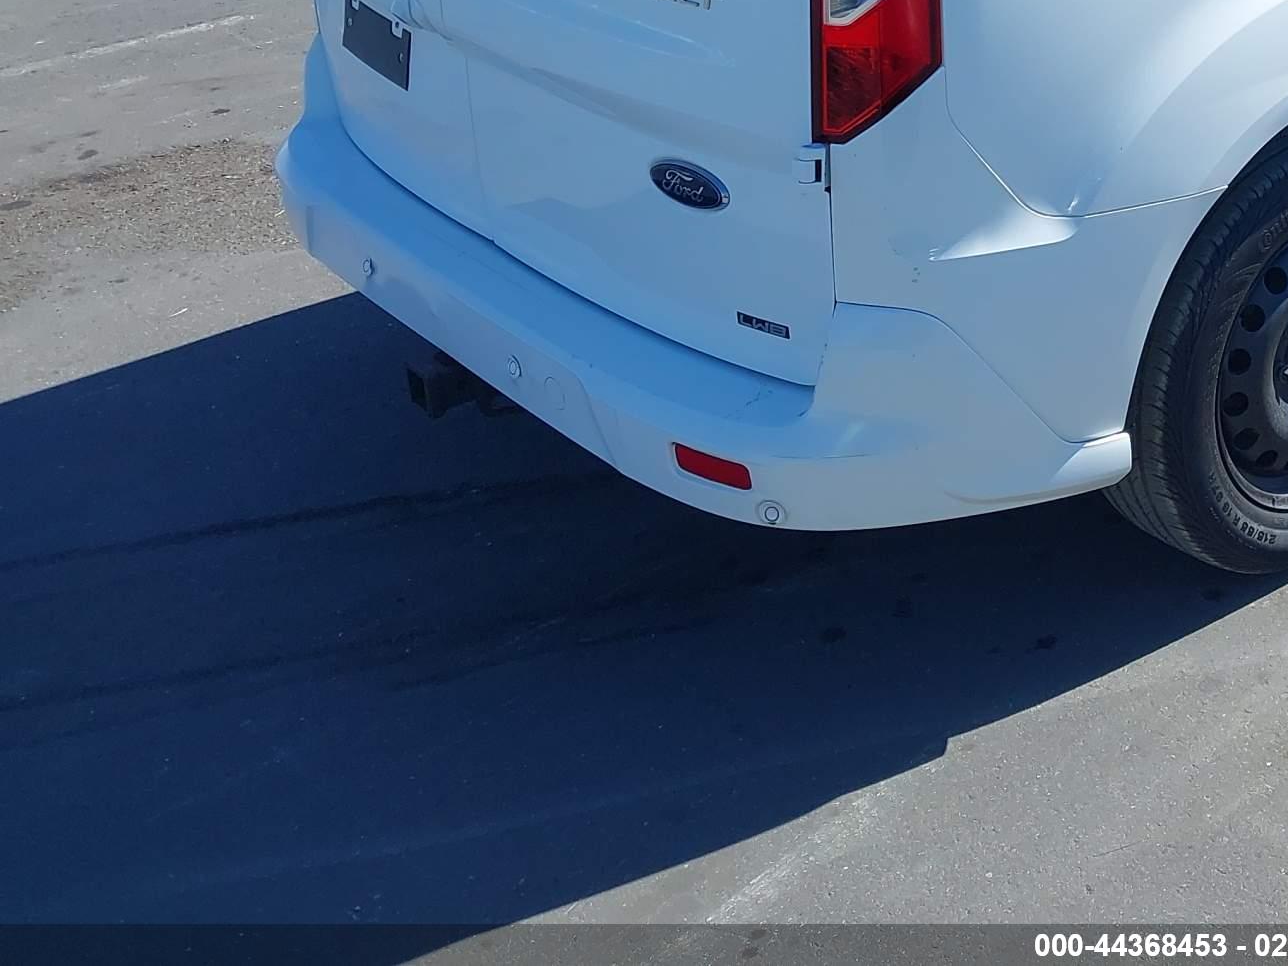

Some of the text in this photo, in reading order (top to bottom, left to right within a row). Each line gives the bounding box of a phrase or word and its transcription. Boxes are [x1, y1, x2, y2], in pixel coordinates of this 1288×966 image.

[662, 169, 705, 203] Ford
[738, 313, 790, 338] LWB
[1231, 515, 1242, 526] R
